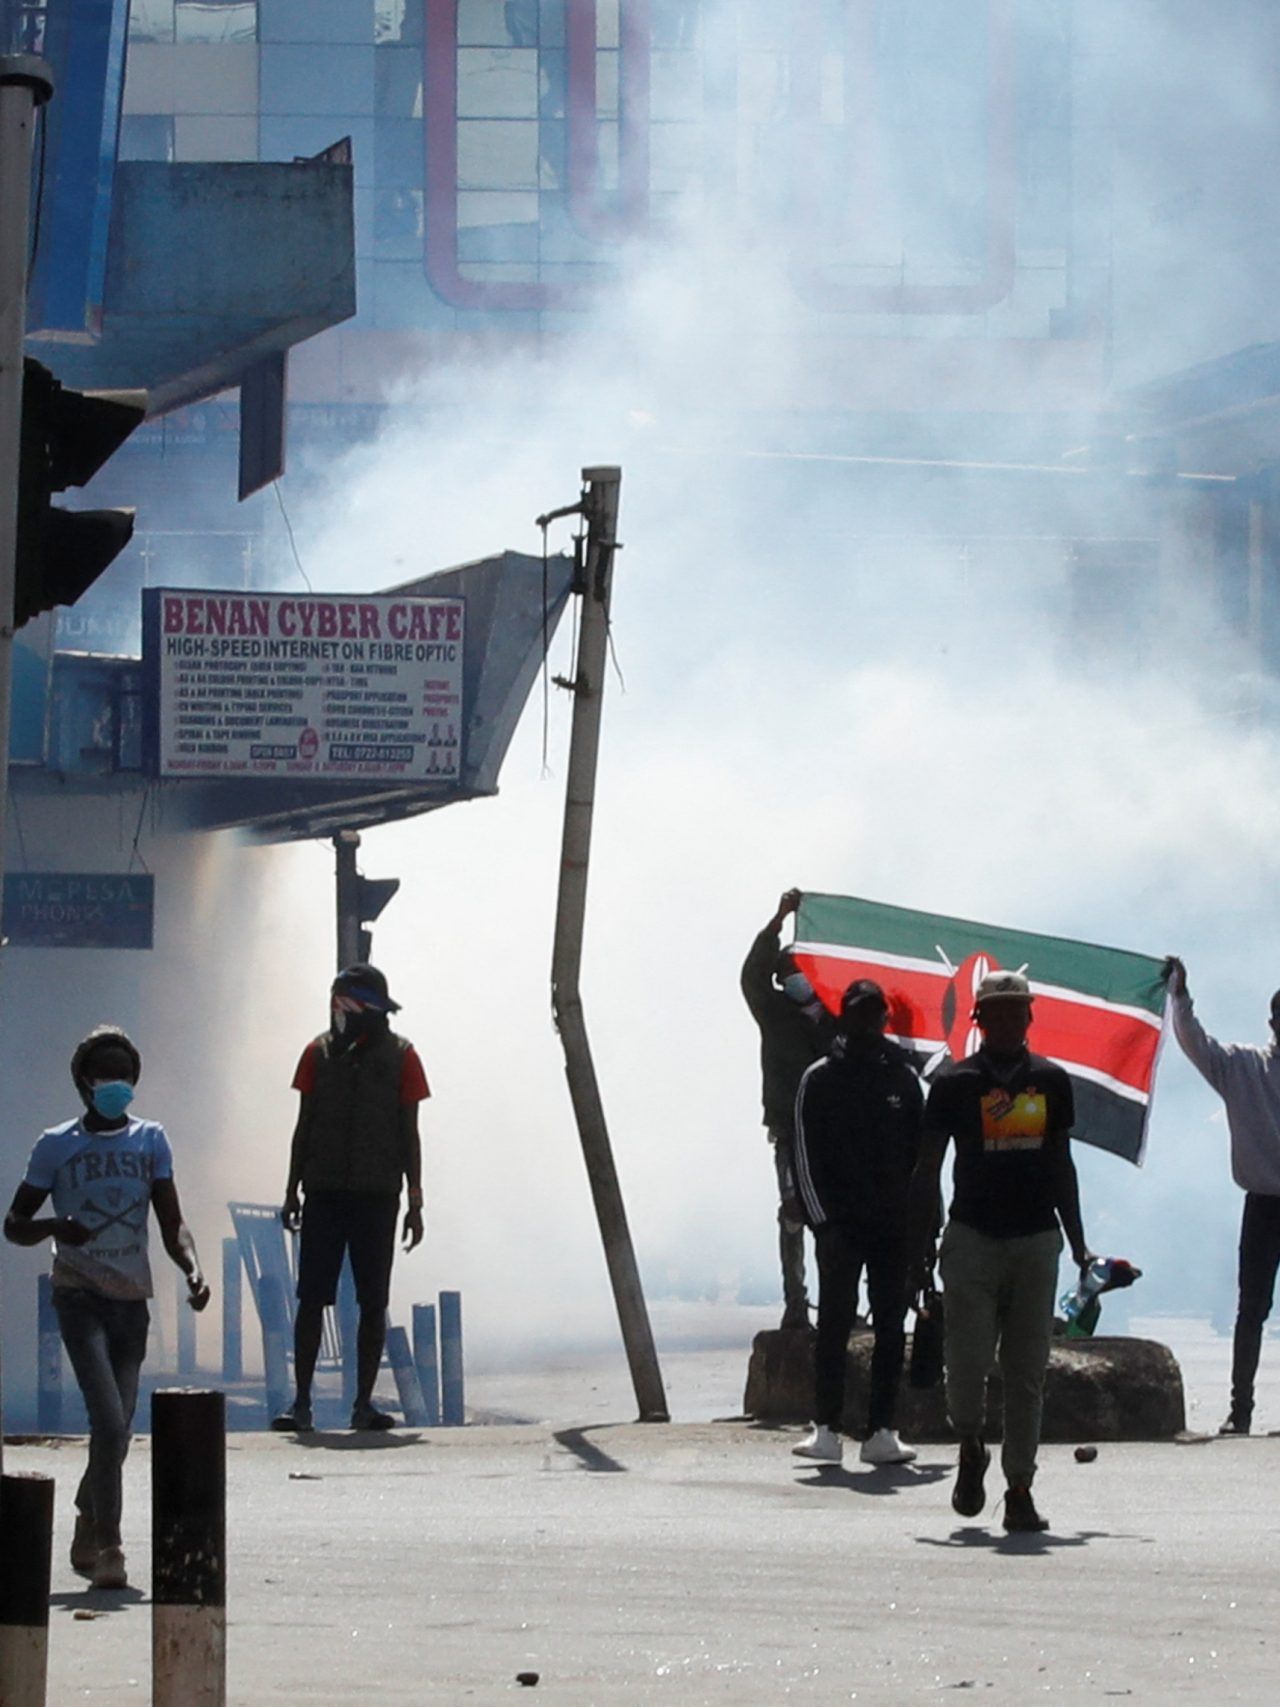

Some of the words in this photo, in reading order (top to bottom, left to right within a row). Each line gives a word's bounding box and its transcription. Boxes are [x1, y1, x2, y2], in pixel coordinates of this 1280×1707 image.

[163, 597, 270, 636] BENAN
[277, 600, 381, 639] CYBER
[387, 603, 462, 641] CAFE
[167, 637, 261, 658] HIGH-SPEED
[264, 639, 341, 660] INTERNET
[342, 641, 364, 661] ON
[369, 642, 413, 661] FIBRE
[415, 643, 456, 663] OPTIC
[65, 1151, 154, 1189] TRASH
